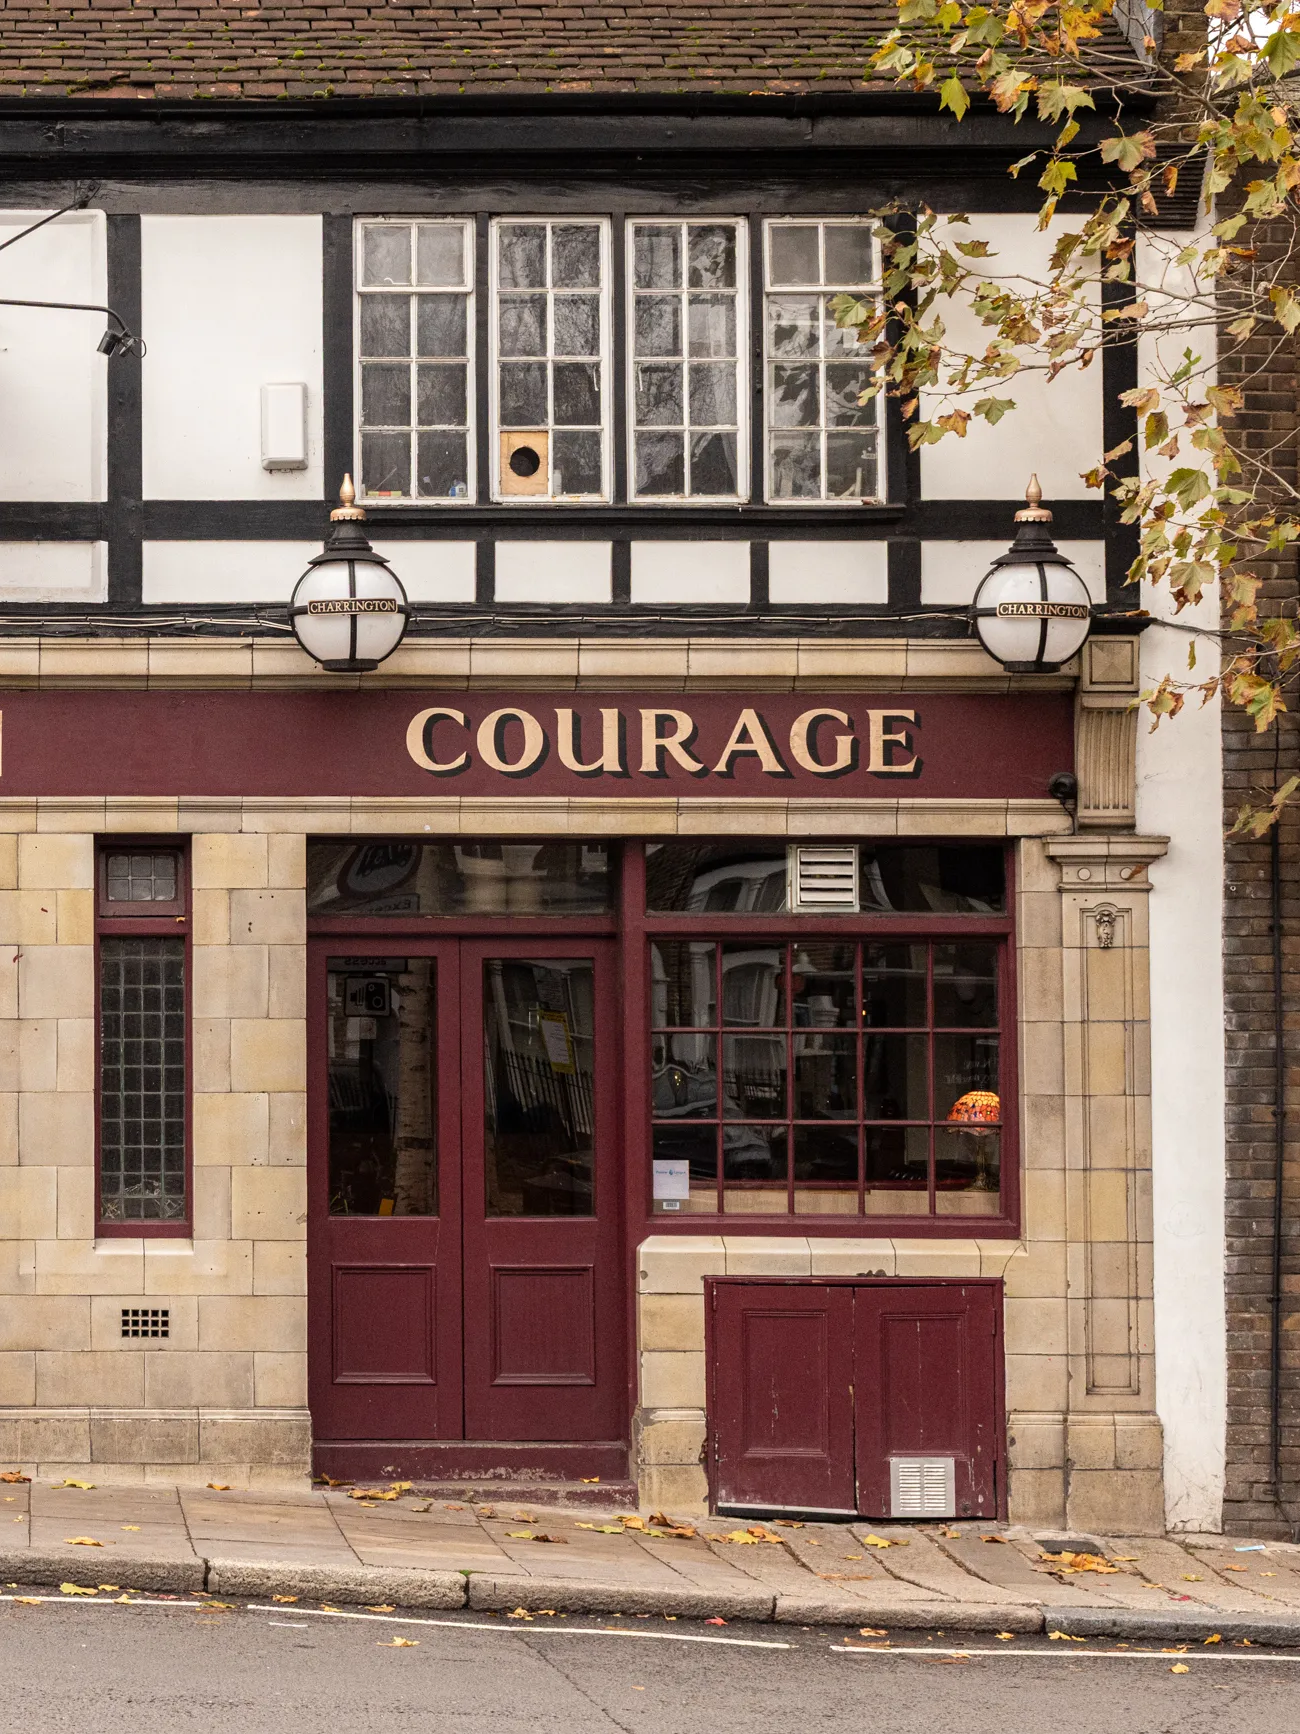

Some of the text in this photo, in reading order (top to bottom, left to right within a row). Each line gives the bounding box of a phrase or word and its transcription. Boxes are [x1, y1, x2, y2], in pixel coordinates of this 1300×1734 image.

[310, 600, 395, 613] CHARRINGTON
[1000, 604, 1087, 617] CHARRINGTON
[405, 707, 921, 776] COURAGE
